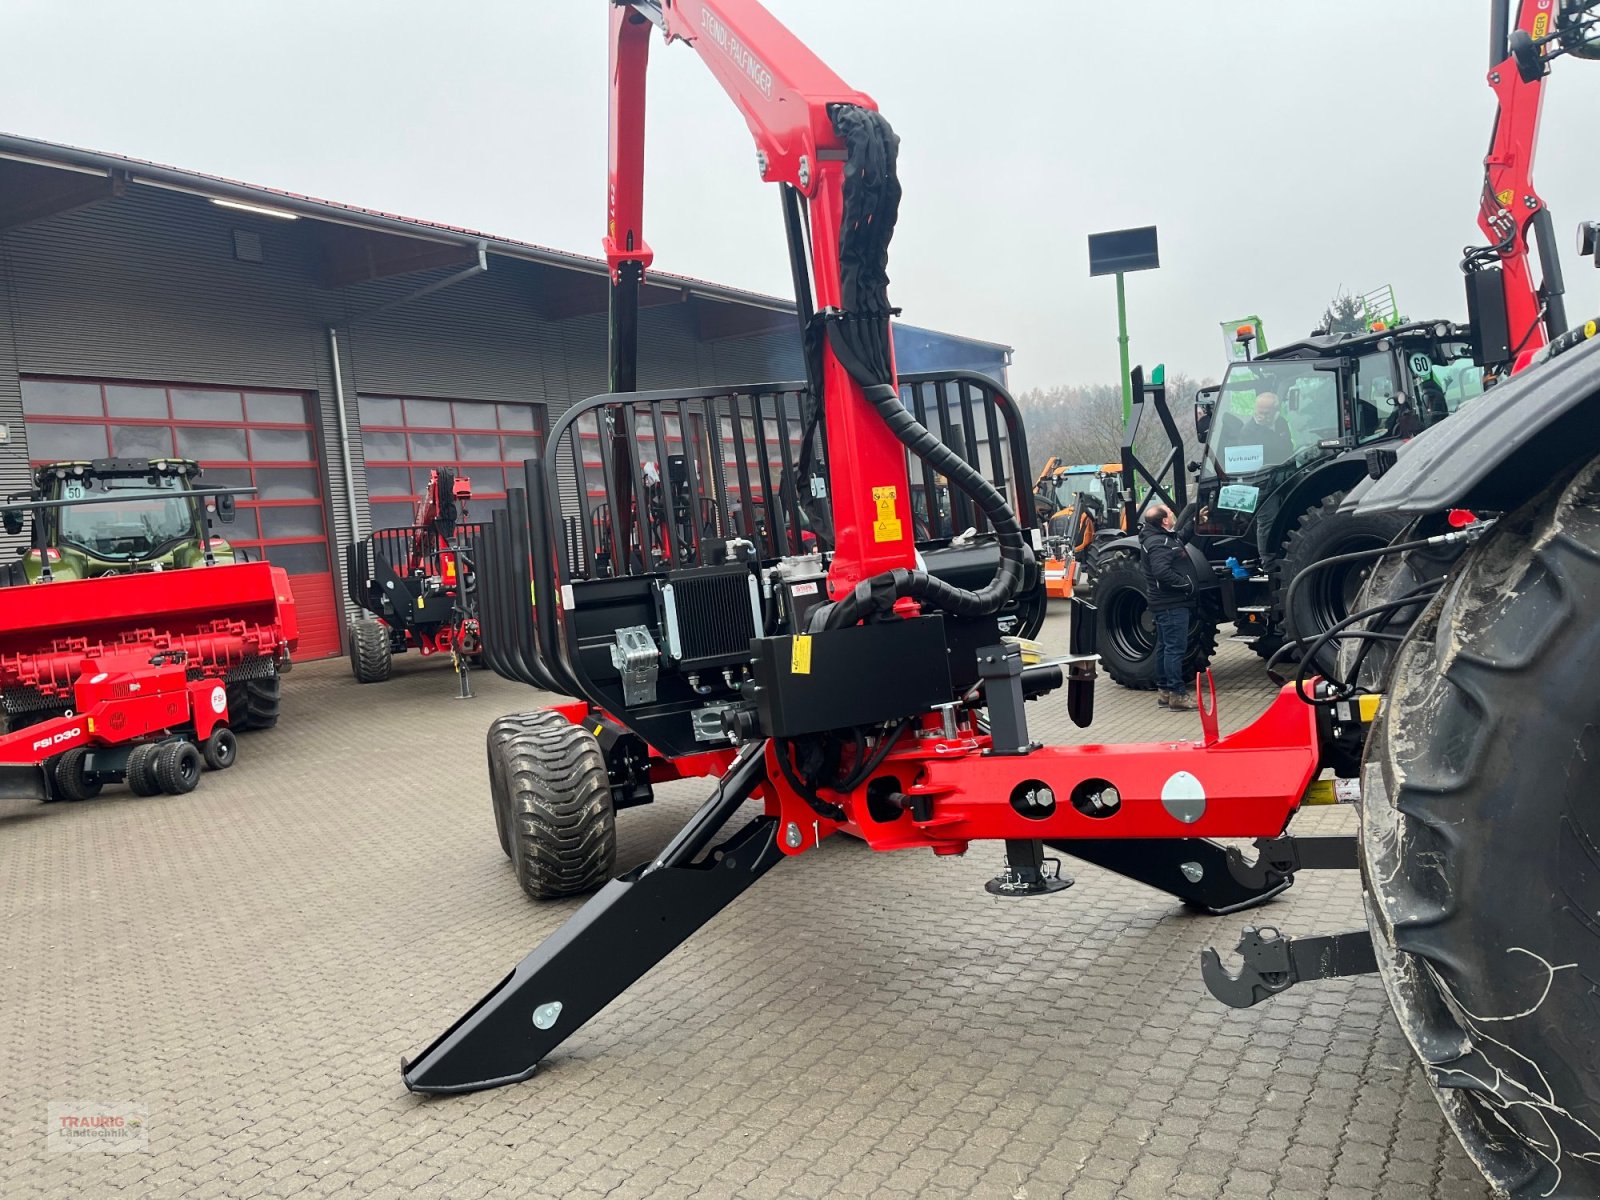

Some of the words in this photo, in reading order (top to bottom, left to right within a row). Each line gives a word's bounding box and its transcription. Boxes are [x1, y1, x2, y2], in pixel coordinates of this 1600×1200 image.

[701, 7, 772, 97] STEINDL-PALFINGER
[1413, 356, 1429, 372] 60
[68, 487, 81, 499] 50
[33, 736, 53, 751] FSI
[54, 727, 81, 744] D30
